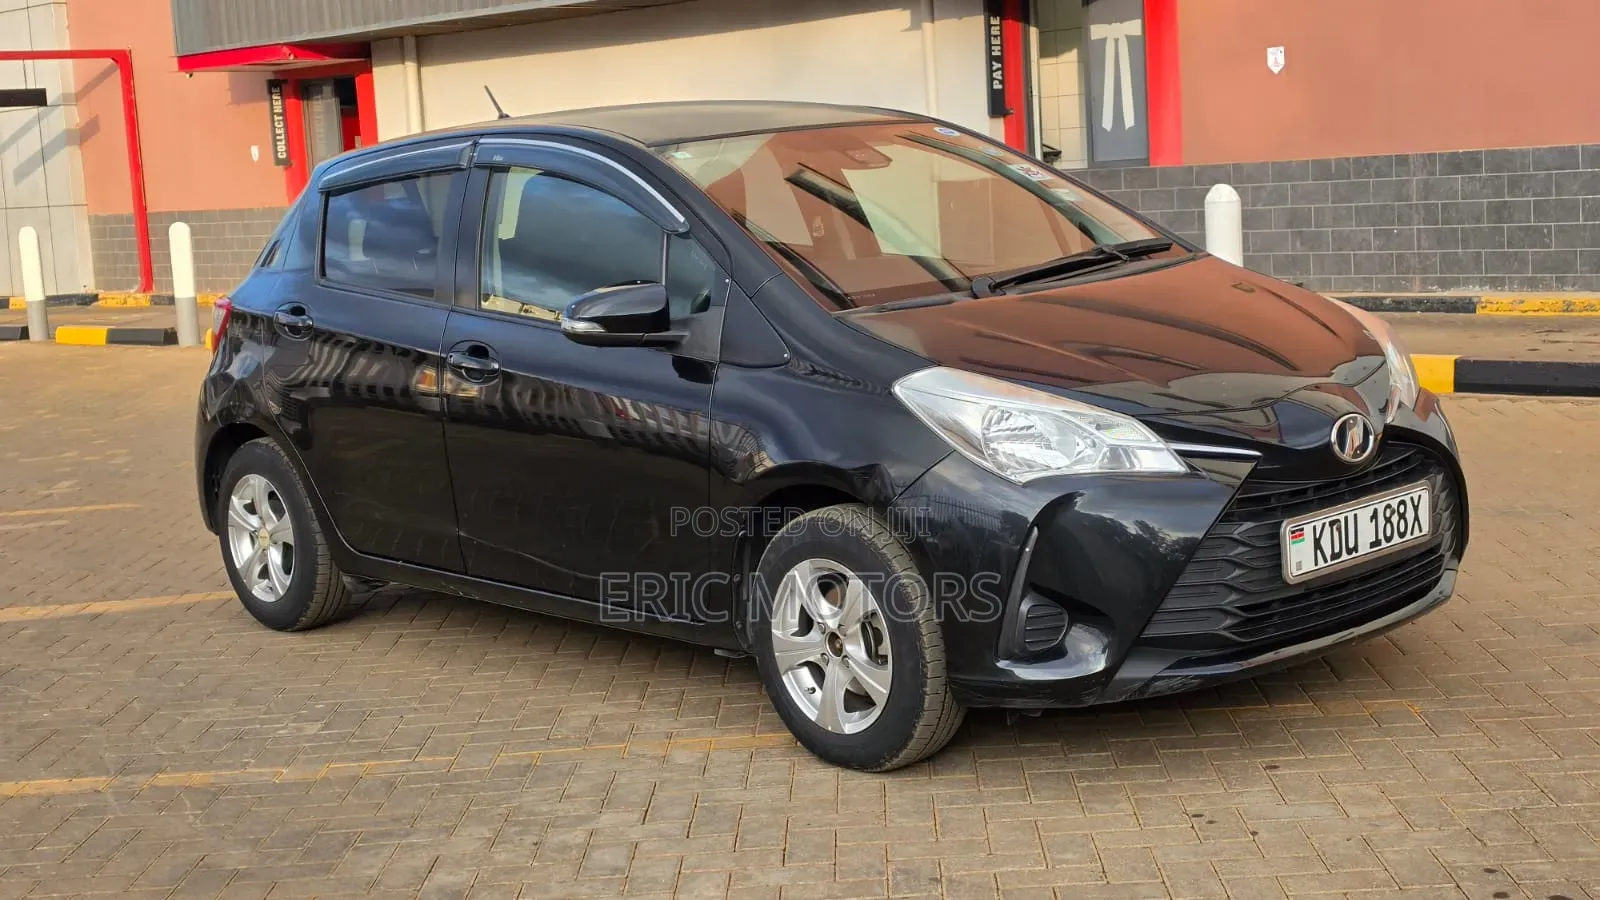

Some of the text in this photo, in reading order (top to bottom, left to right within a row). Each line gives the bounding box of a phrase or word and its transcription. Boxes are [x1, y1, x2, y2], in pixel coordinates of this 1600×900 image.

[990, 16, 1003, 90] PAY HERE
[271, 87, 286, 159] COLLECT HERE
[1312, 494, 1423, 567] KDU 188X
